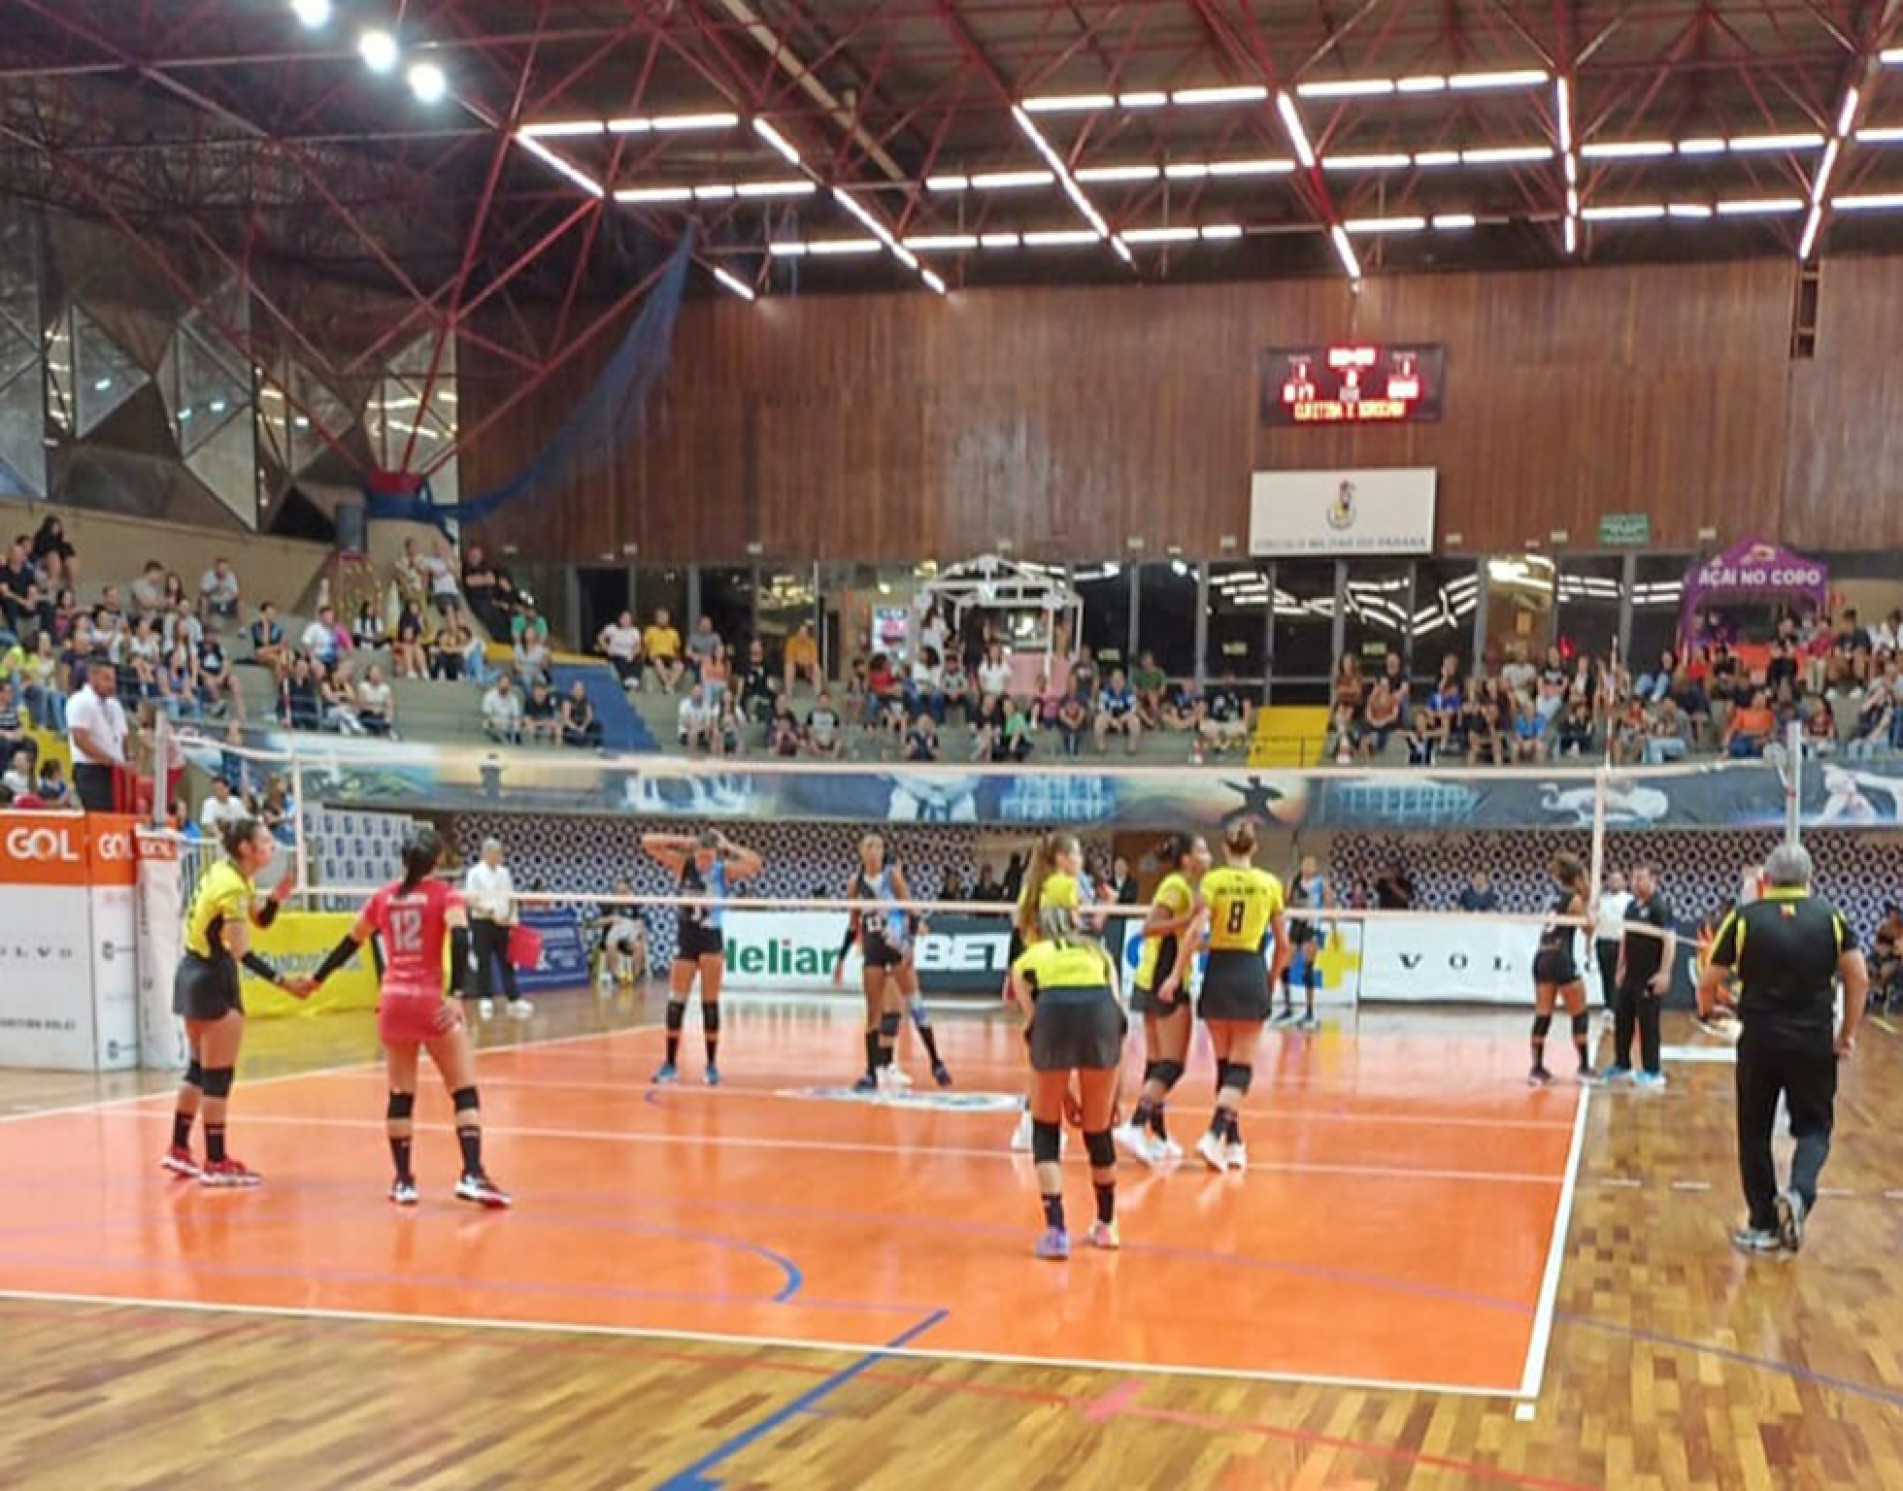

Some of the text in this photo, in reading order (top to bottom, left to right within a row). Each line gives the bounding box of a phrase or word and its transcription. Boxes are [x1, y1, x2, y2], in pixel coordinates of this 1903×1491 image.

[1741, 569, 1766, 585] NO
[6, 827, 80, 861] GOL
[390, 909, 423, 952] 12
[1228, 900, 1245, 934] 8
